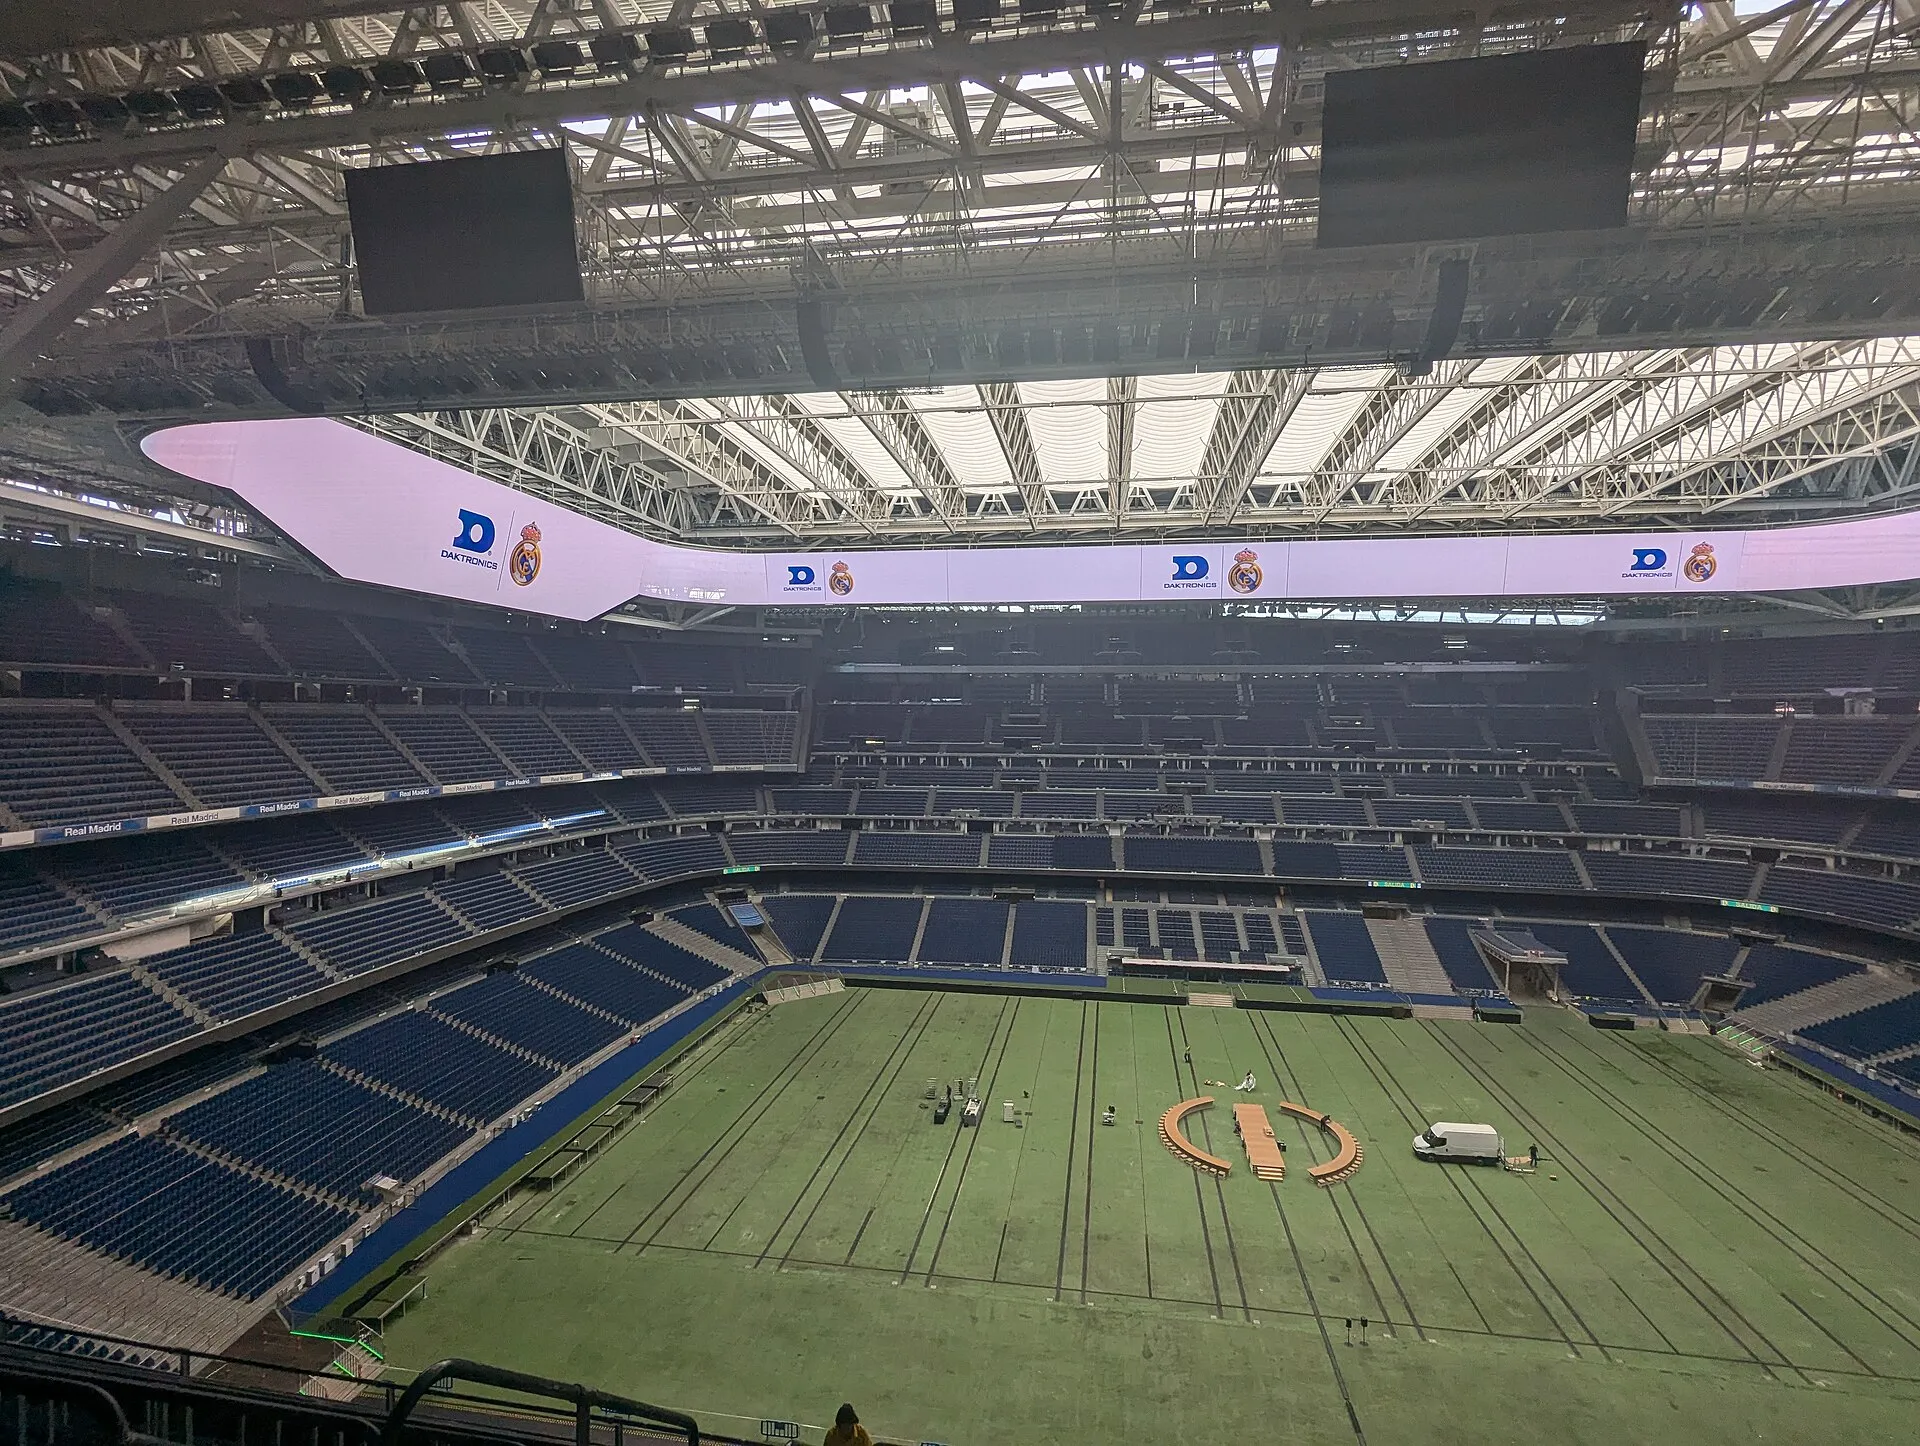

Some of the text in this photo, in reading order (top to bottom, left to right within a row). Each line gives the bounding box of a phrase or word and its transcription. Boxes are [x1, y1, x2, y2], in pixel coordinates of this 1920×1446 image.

[440, 549, 498, 570] DAKTRONICS
[411, 788, 430, 796] Madrid
[334, 795, 370, 805] Real Madrid
[259, 801, 300, 813] Real Madrid
[171, 812, 219, 825] Real Madrid
[64, 822, 122, 838] Real Madrid
[1735, 901, 1762, 910] SALIDA
